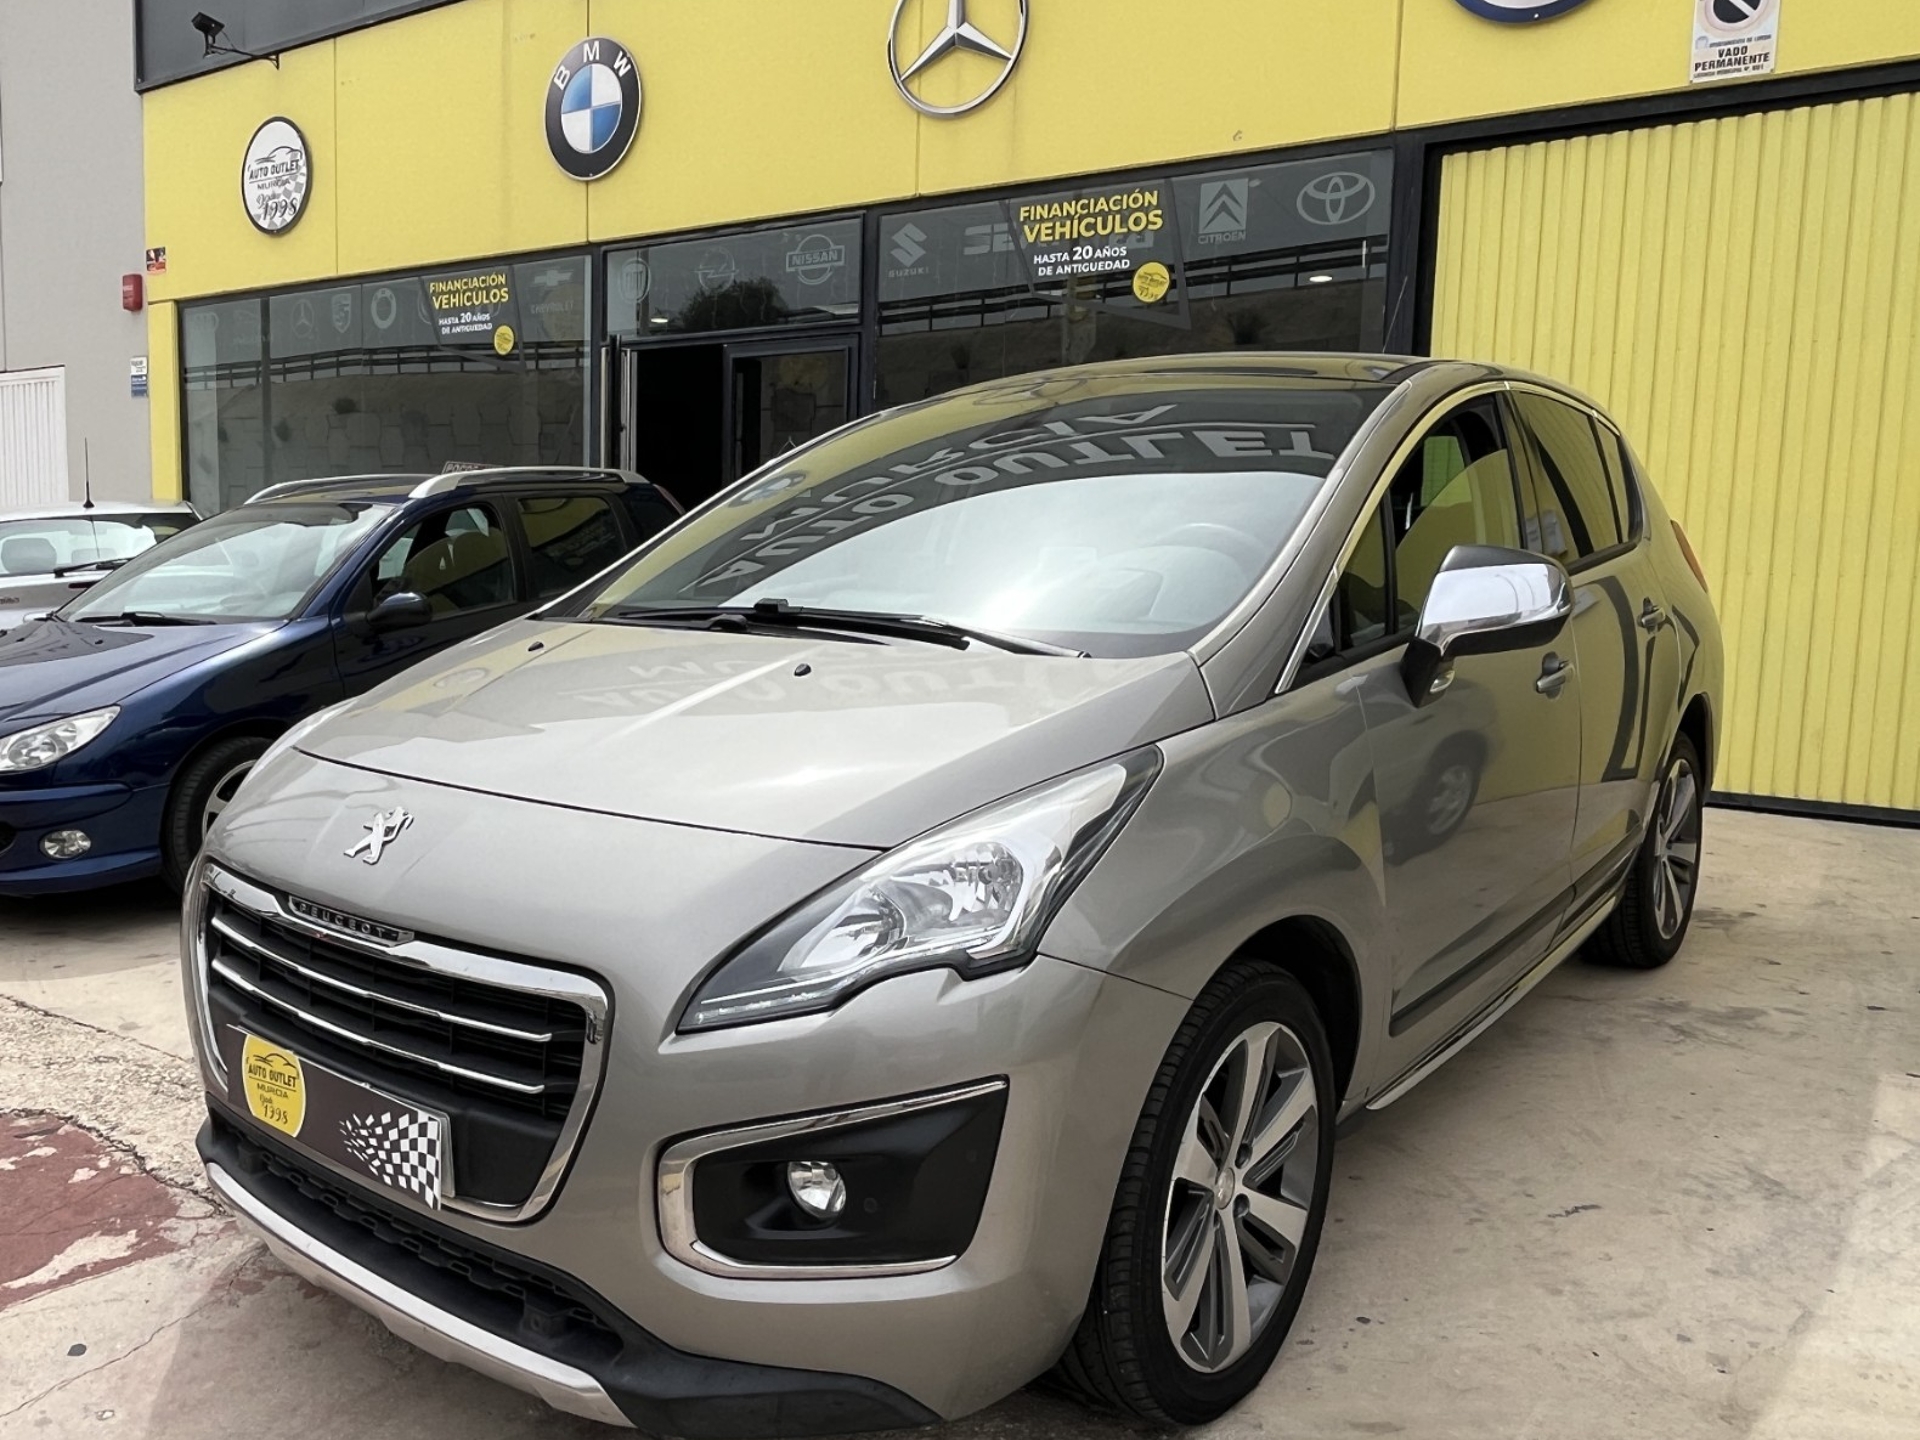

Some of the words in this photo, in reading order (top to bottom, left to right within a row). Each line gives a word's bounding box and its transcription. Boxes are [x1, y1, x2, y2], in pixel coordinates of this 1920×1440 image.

[1718, 45, 1748, 58] VADO
[553, 40, 632, 91] BMW
[1694, 52, 1770, 72] PERMANENTE
[249, 165, 269, 180] AUTO
[271, 159, 300, 175] OUTLET
[263, 198, 297, 221] 1998
[1019, 188, 1158, 222] FINANCIACIÓN
[1023, 209, 1163, 243] VEHÍCULOS
[791, 250, 838, 266] NISSAN
[1033, 252, 1070, 265] HASTA
[1072, 245, 1093, 261] 20
[1094, 246, 1127, 259] AÑOS
[888, 266, 929, 278] SUZUKI
[1038, 266, 1053, 276] DE
[1055, 259, 1130, 275] ANTIGUEDAD
[429, 272, 506, 294] FINANCIACIÓN
[432, 287, 509, 310] VEHÍCULOS
[438, 316, 459, 326] HASTA
[460, 311, 472, 323] 20
[472, 312, 491, 321] AÑOS
[441, 326, 450, 335] DE
[300, 903, 385, 938] PEUGEOT
[248, 1063, 267, 1079] AUTO
[269, 1069, 297, 1088] OUTLET
[256, 1082, 289, 1099] MURCIA
